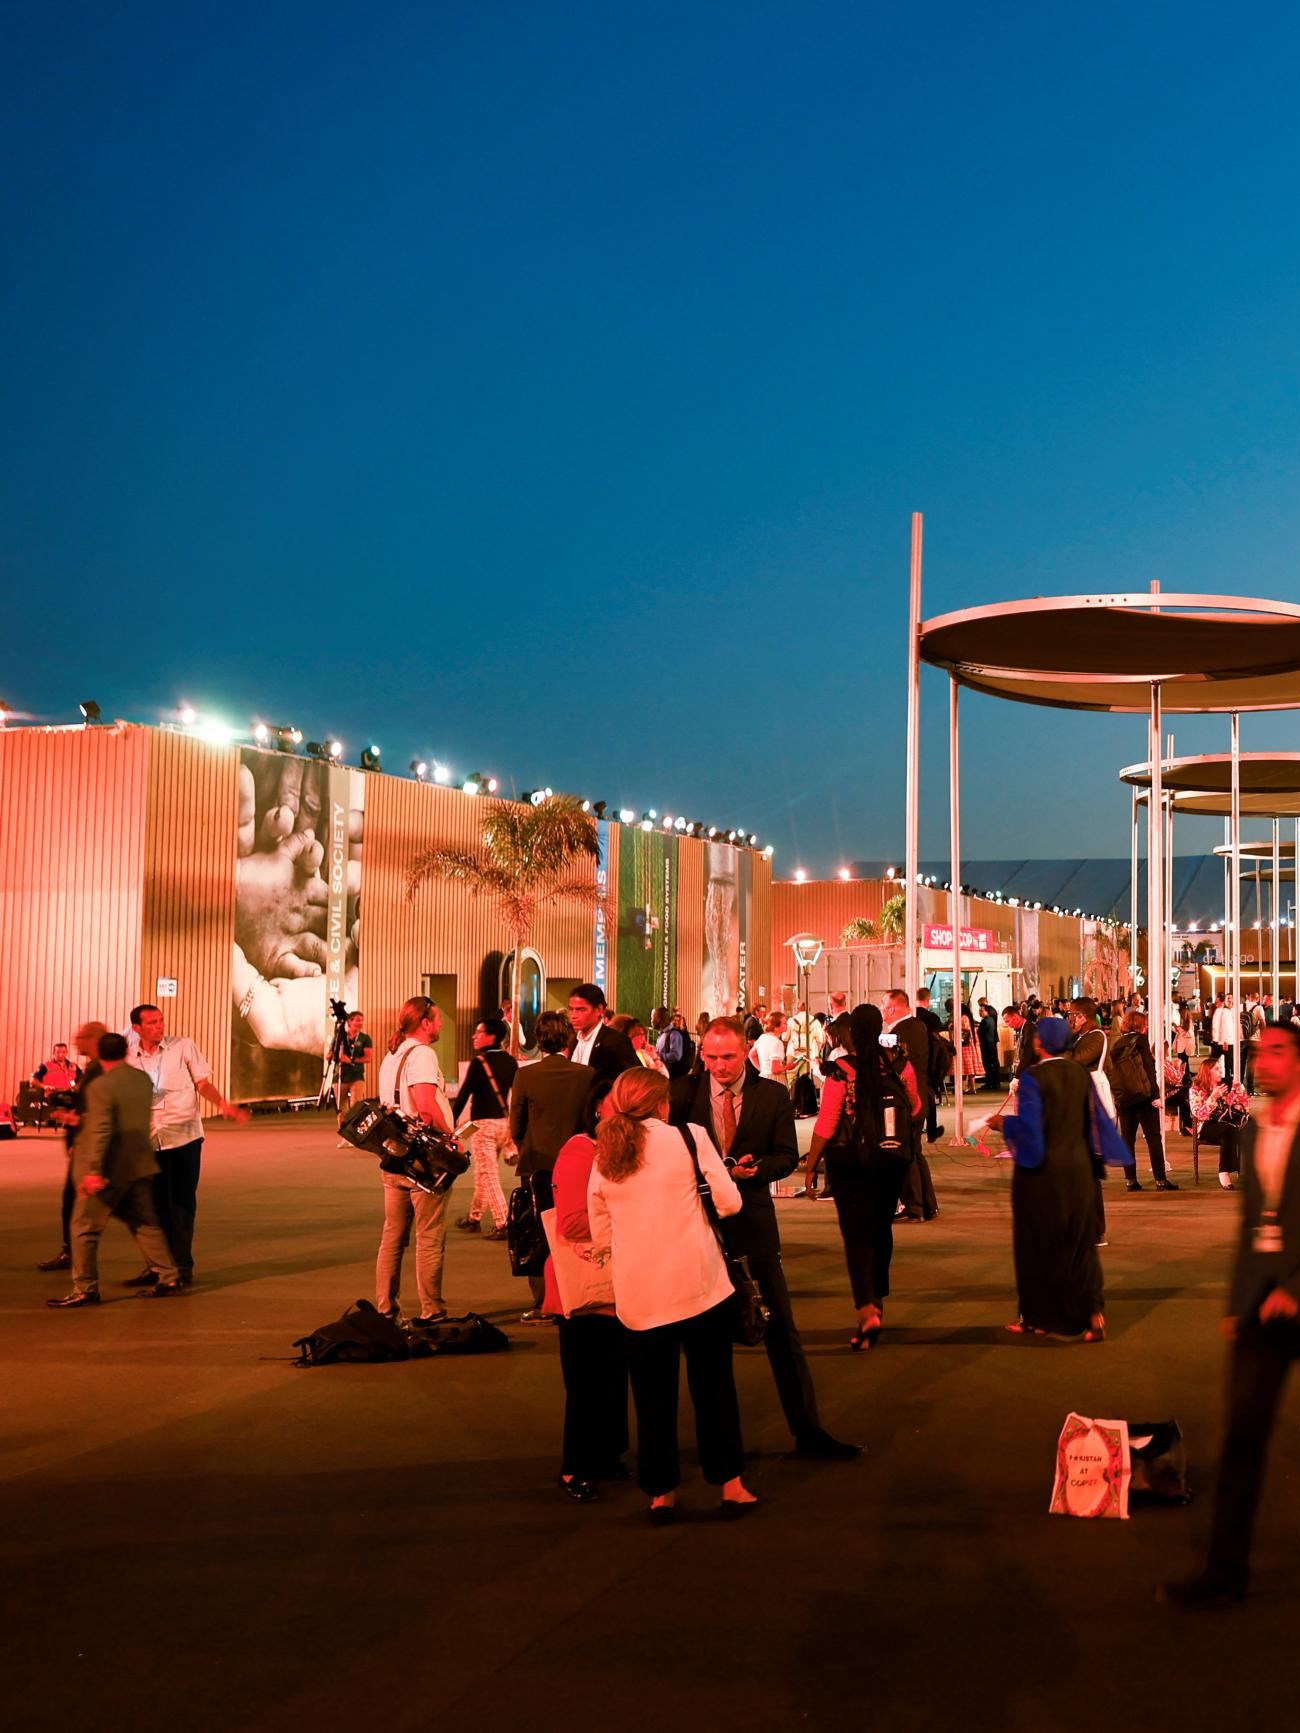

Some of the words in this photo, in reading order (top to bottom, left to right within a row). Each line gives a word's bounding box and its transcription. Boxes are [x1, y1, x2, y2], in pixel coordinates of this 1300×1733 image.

[333, 802, 344, 894] SOCIETY
[331, 900, 342, 953] CIVIL
[930, 929, 953, 946] SHOP
[330, 959, 341, 973] &
